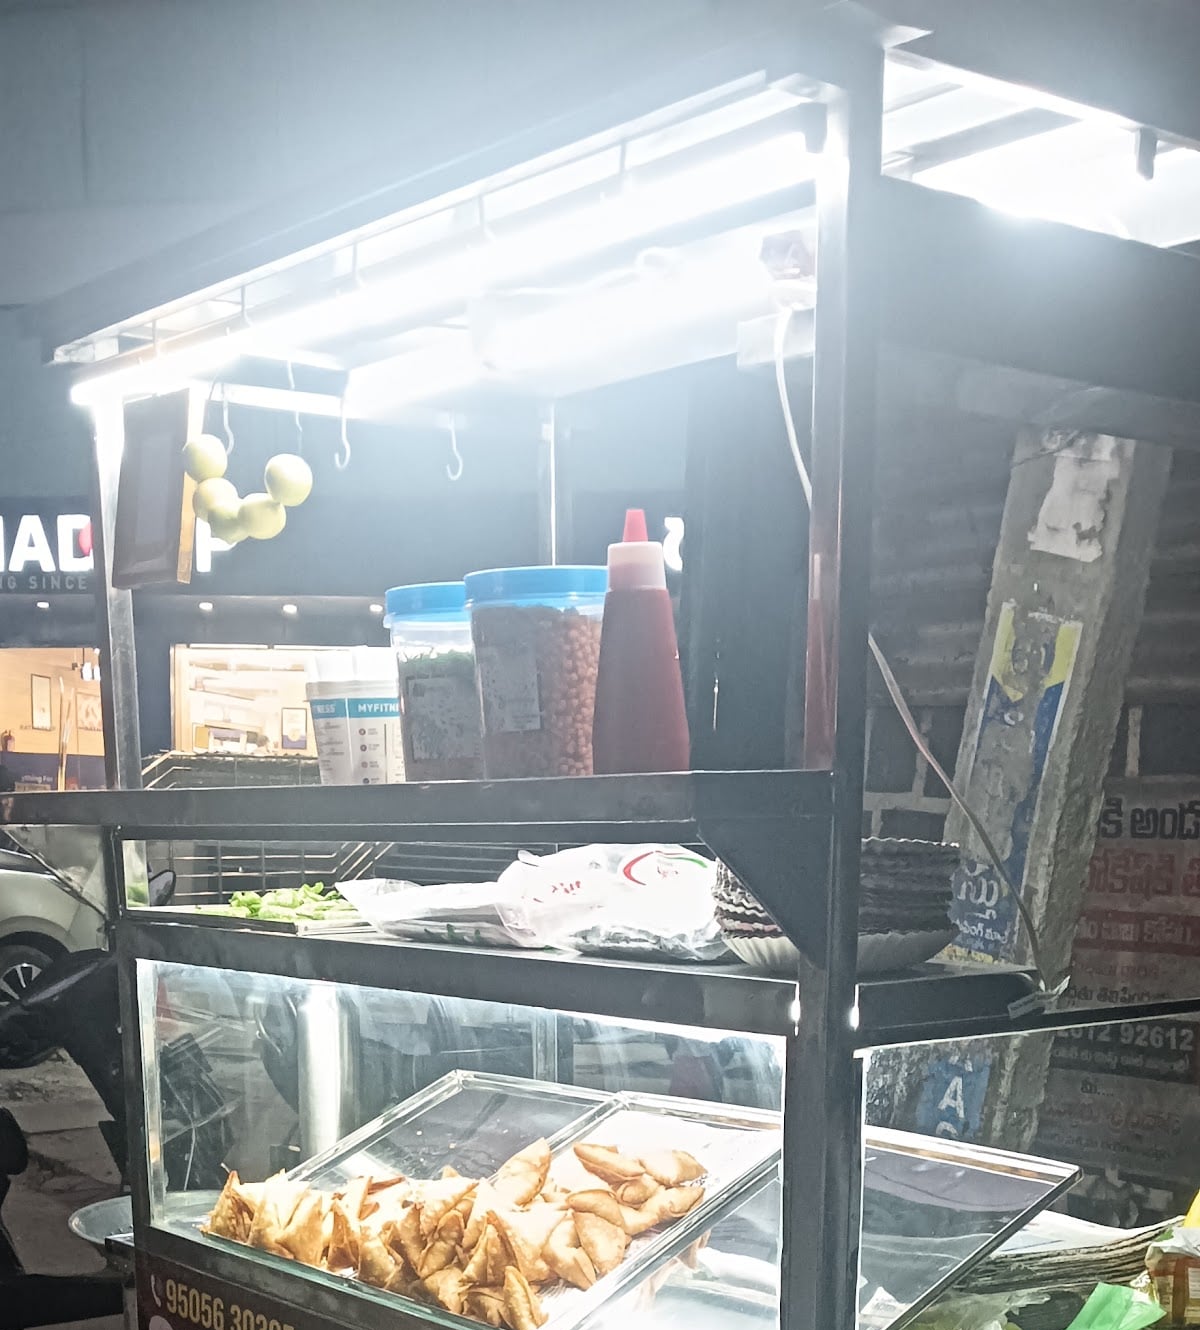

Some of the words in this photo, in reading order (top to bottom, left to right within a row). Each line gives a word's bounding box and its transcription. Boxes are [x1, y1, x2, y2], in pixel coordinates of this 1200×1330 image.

[0, 514, 94, 572] AD
[29, 576, 87, 590] SINCE
[1120, 1023, 1194, 1051] 92612
